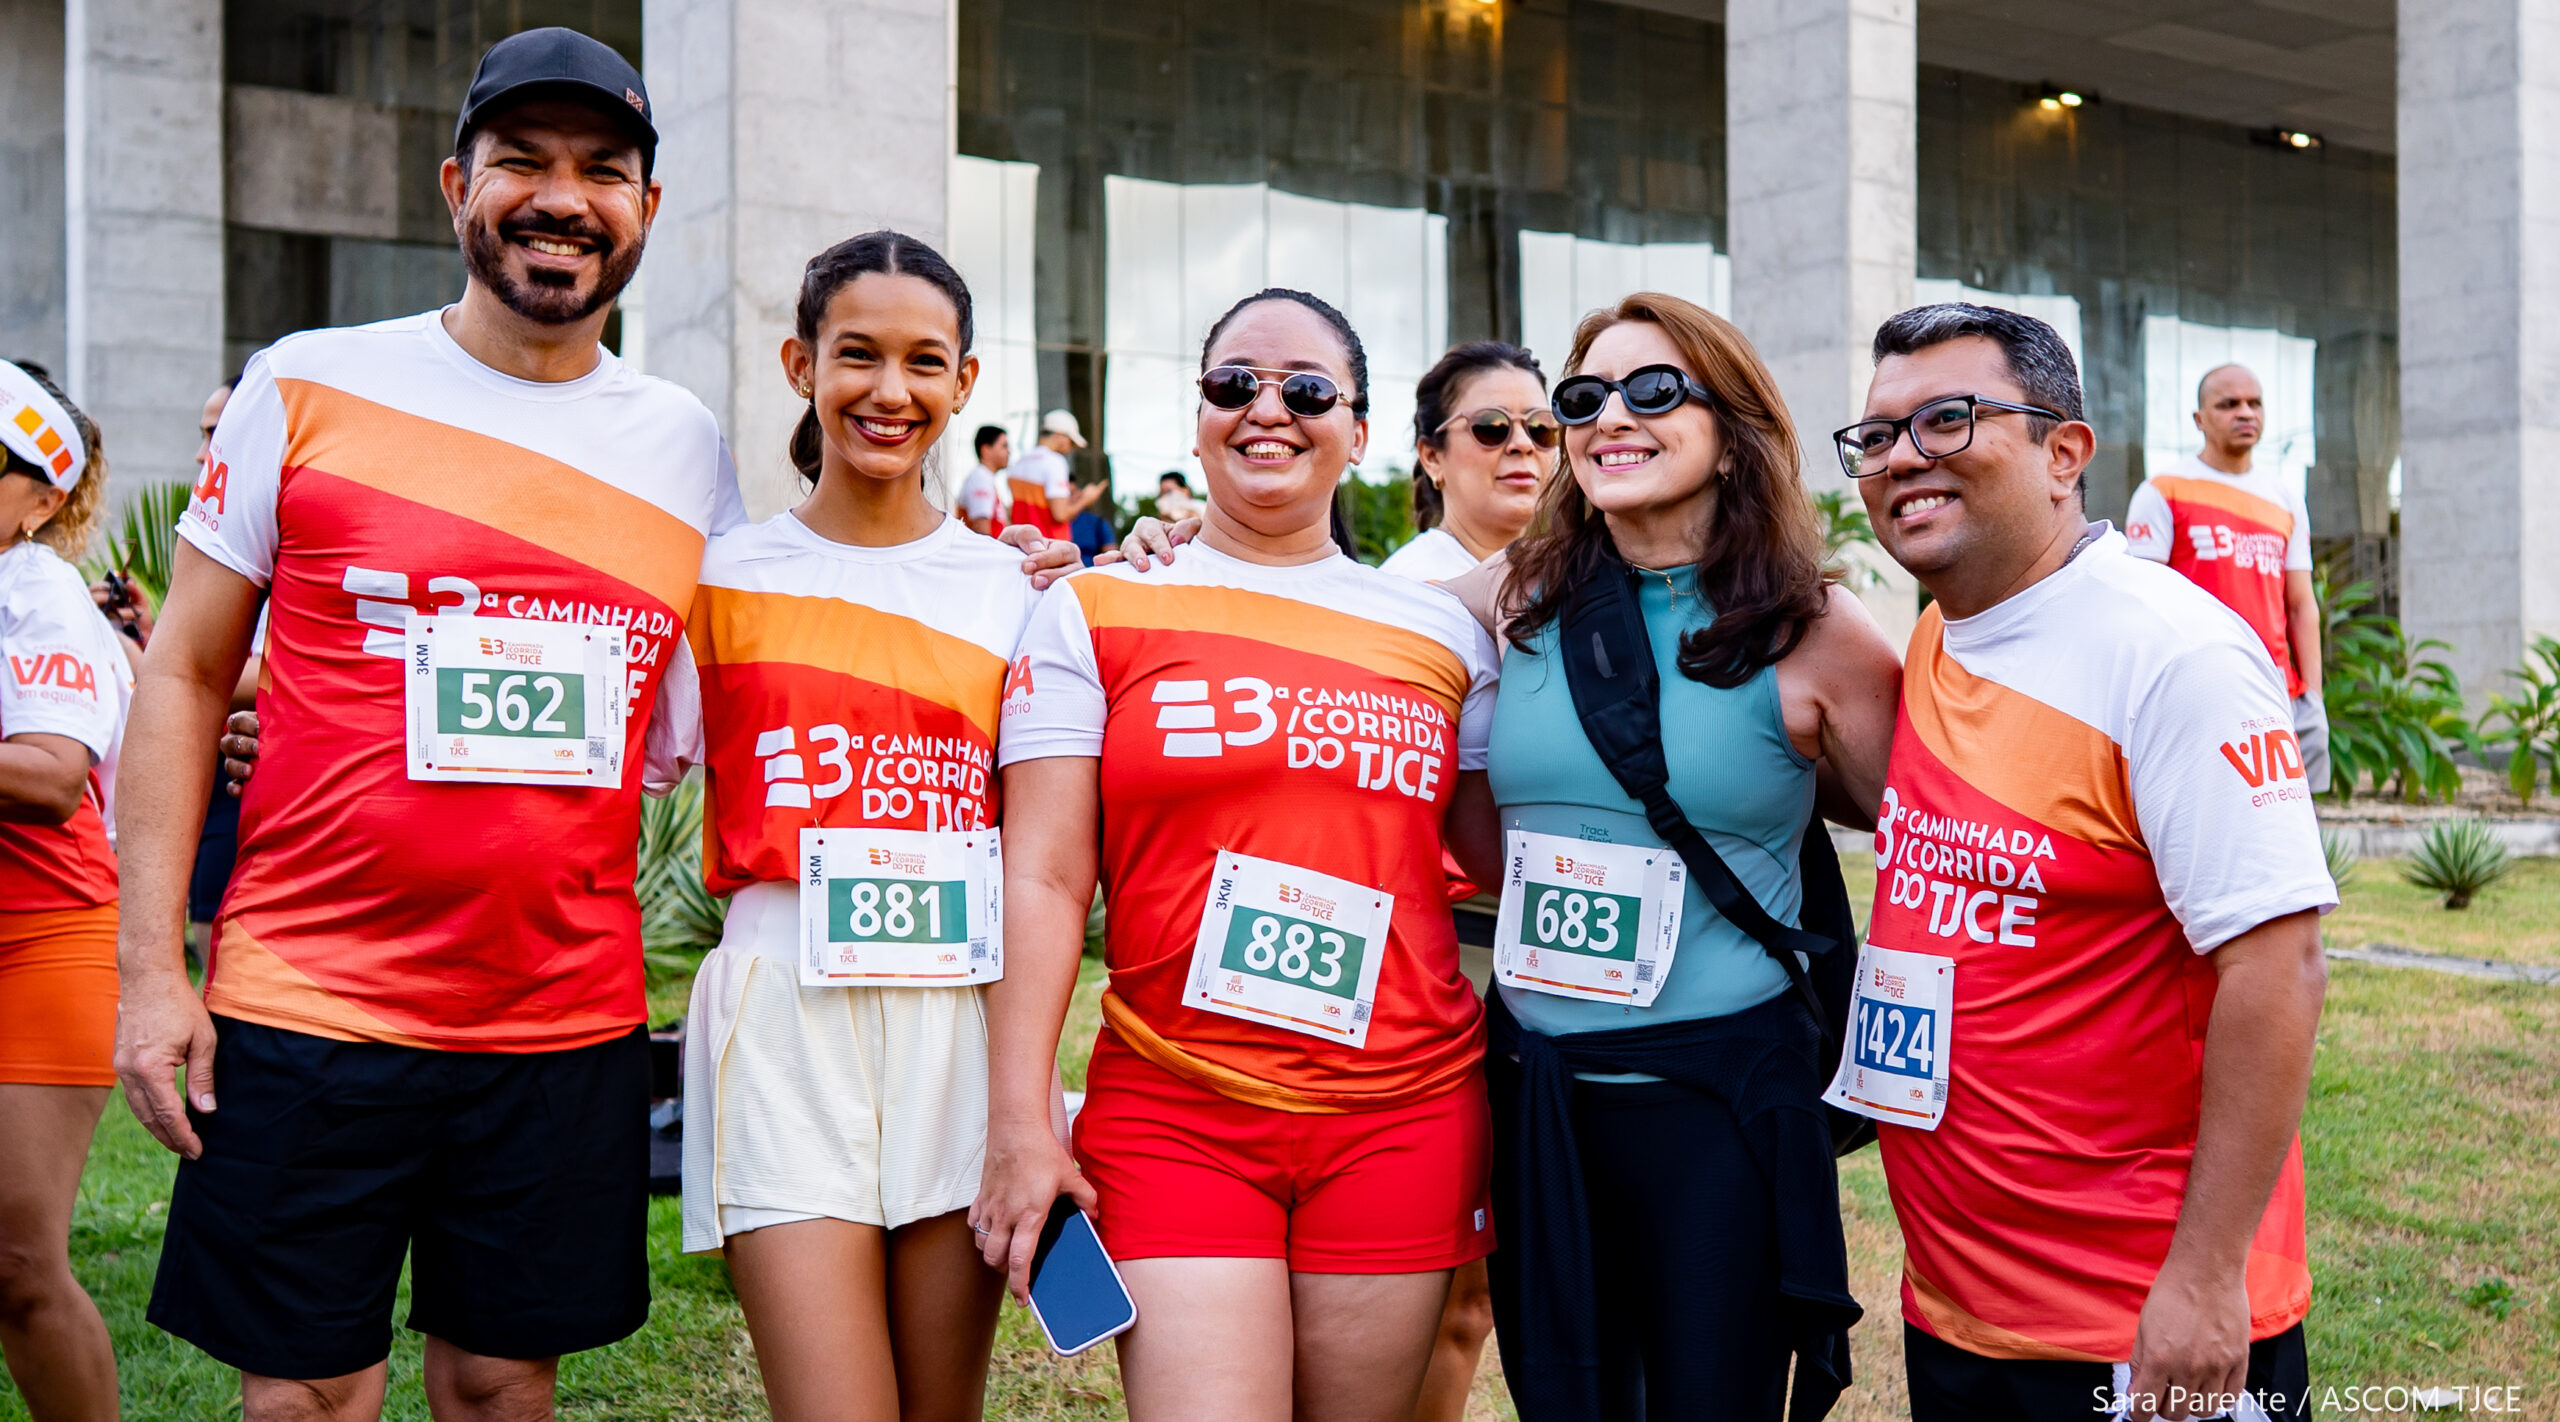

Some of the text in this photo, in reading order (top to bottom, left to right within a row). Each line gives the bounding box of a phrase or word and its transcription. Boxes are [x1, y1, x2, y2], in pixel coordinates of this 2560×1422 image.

[507, 595, 674, 639] CAMINHADA
[416, 644, 429, 675] 3KM
[518, 655, 542, 665] TJCE
[9, 652, 98, 702] VIDA
[460, 673, 566, 732] 562
[1297, 687, 1447, 729] CAMINHADA
[1286, 706, 1445, 755] /CORRIDA
[449, 747, 469, 756] TJCE
[2220, 729, 2305, 788] VID
[1288, 736, 1441, 802] DO TJCE
[862, 787, 913, 820] DO
[2251, 791, 2277, 807] em
[1580, 824, 1609, 836] Track
[1908, 810, 2056, 860] CAMINHADA
[810, 855, 822, 886] 3KM
[904, 864, 925, 875] TJCE
[1512, 856, 1524, 886] 3KM
[1896, 833, 2047, 893] /CORRIDA
[1215, 879, 1233, 910] 3KM
[1584, 874, 1604, 886] TJCE
[850, 882, 941, 938] 881
[1312, 907, 1332, 920] TJCE
[1536, 890, 1620, 952] 683
[1889, 868, 2039, 947] DO TJCE
[840, 955, 858, 963] TJCE
[1244, 915, 1346, 987] 883
[1526, 957, 1539, 968] TJCE
[1890, 987, 1904, 999] TJCE
[1859, 1003, 1933, 1073] 1424
